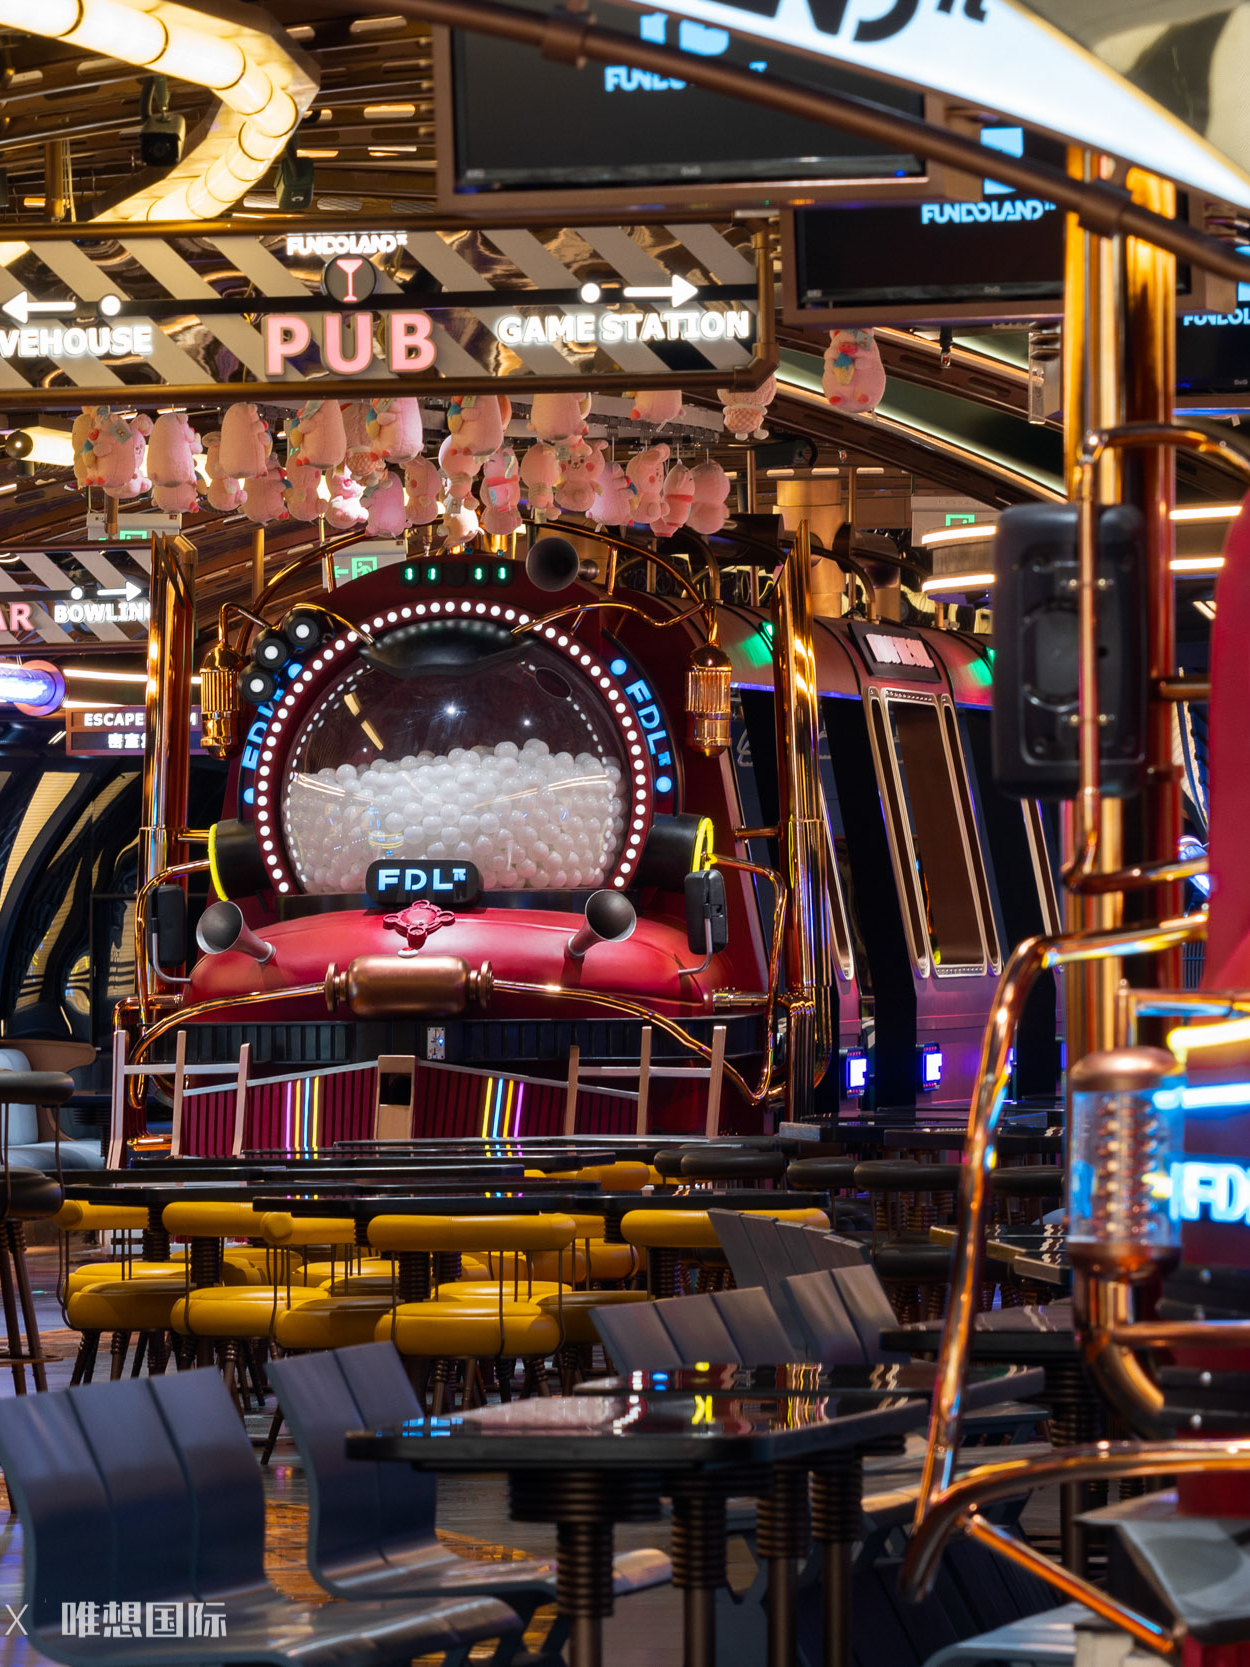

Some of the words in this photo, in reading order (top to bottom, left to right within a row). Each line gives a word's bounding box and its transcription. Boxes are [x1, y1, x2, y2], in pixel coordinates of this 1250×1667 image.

[266, 312, 437, 374] PUB
[498, 314, 595, 343] GAME
[600, 311, 750, 341] STATION
[83, 712, 145, 727] ESCAPE
[1180, 1161, 1250, 1226] FD
